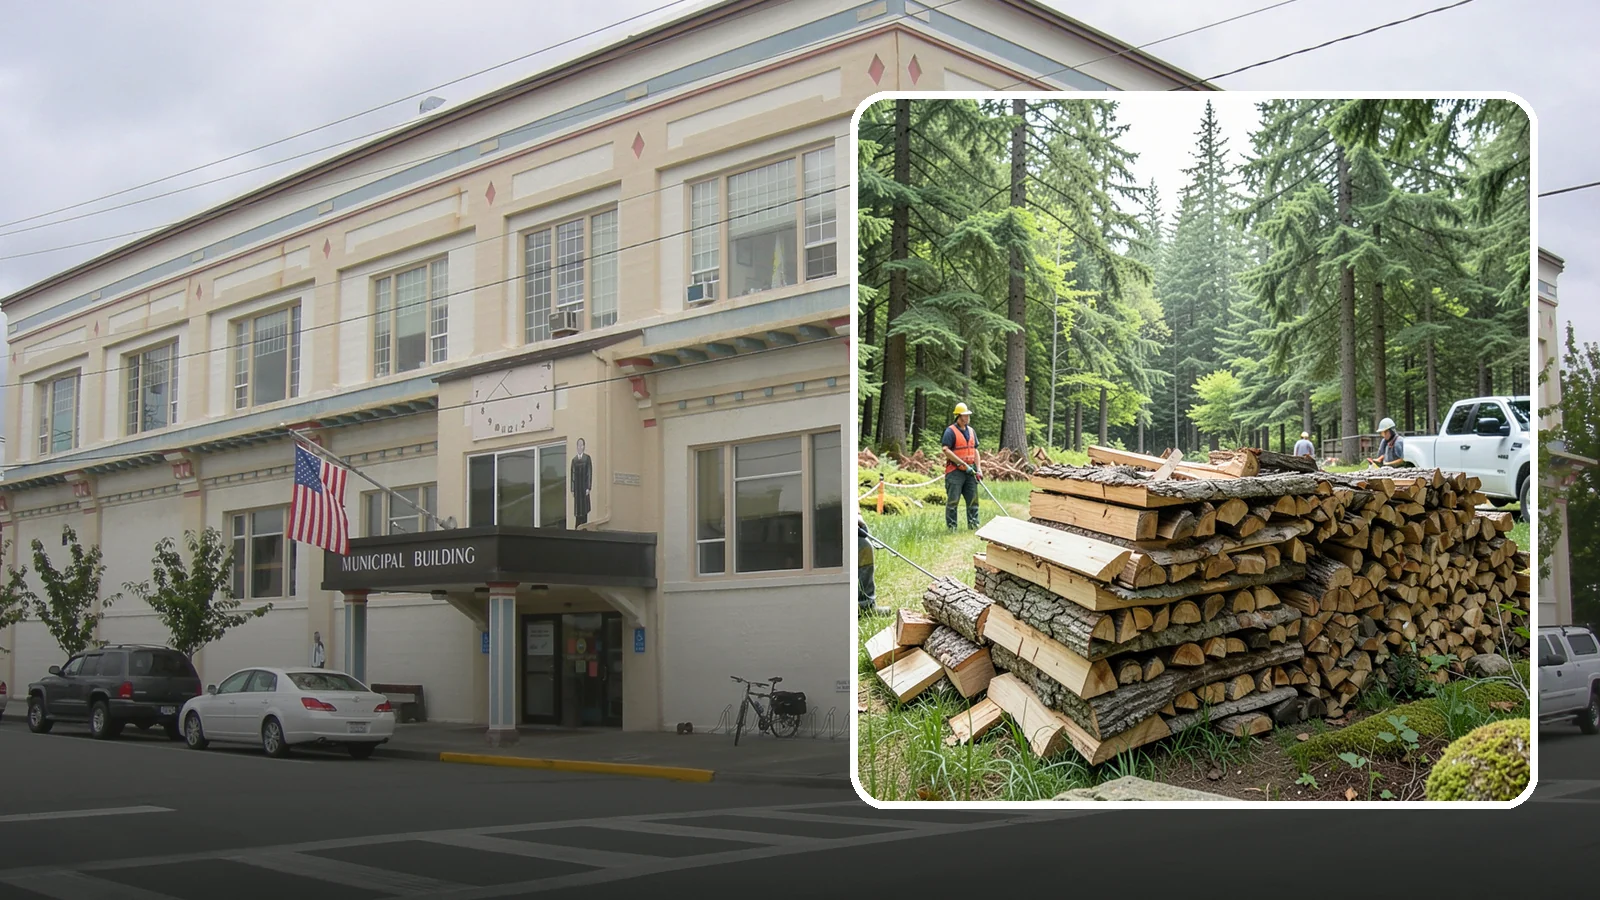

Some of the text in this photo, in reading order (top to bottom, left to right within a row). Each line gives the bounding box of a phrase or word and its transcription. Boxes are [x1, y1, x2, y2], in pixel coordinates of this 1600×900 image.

[481, 407, 485, 415] 8
[487, 417, 492, 426] 9
[494, 423, 500, 432] 10
[501, 425, 506, 434] 11
[507, 425, 513, 434] 12
[521, 420, 526, 428] 2
[528, 413, 533, 422] 3
[536, 402, 540, 410] 4
[342, 546, 475, 572] MUNICIPAL BUILDING
